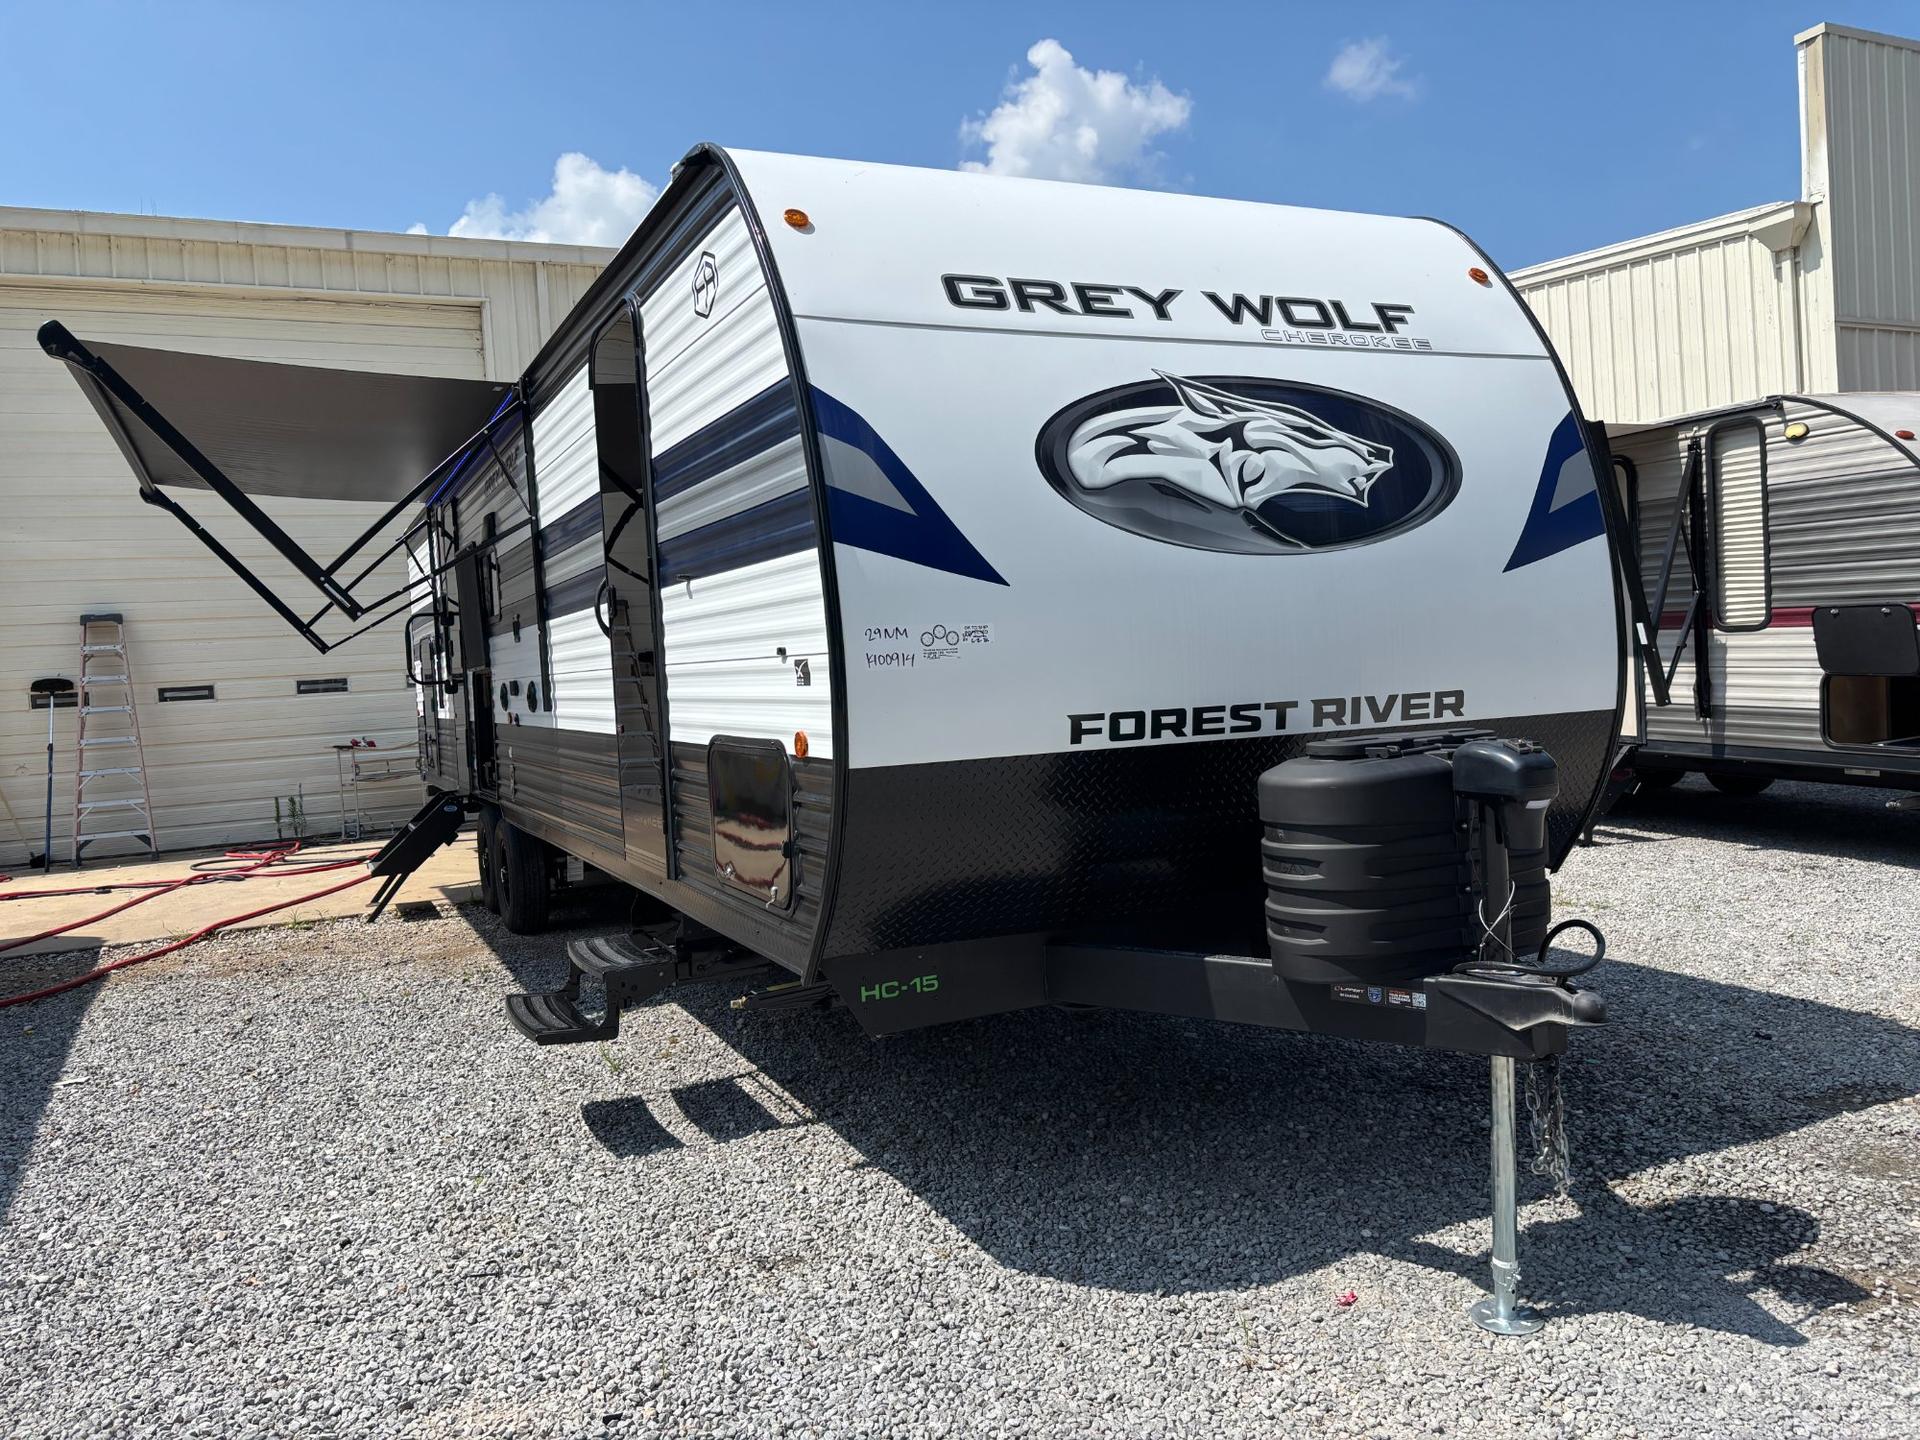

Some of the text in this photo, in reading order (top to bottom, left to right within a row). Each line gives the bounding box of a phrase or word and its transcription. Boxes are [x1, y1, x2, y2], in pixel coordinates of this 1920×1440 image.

[941, 273, 1415, 334] GREY WOLF
[1261, 329, 1432, 352] CHEROKEE
[864, 626, 909, 642] 29NM
[1067, 689, 1465, 745] FOREST RIVER
[860, 974, 939, 1003] HC-15
